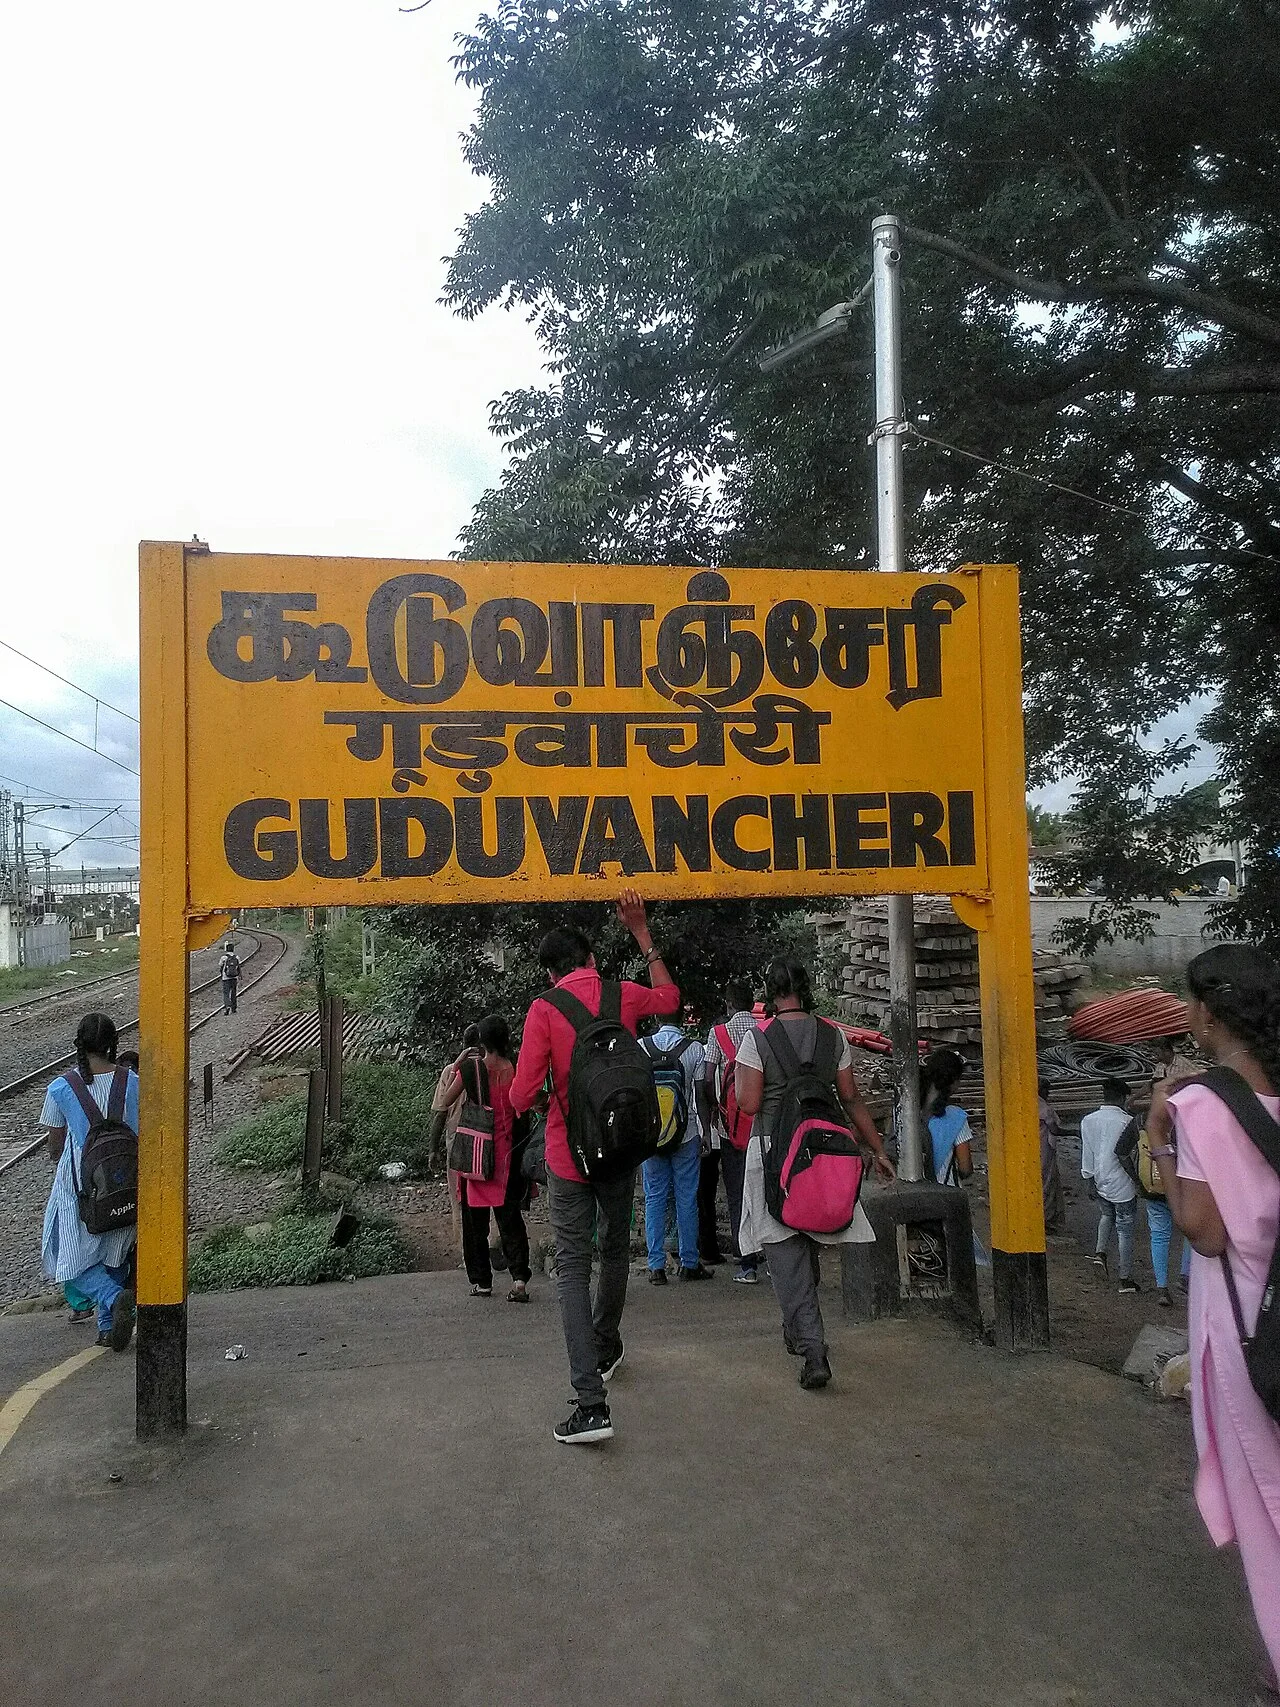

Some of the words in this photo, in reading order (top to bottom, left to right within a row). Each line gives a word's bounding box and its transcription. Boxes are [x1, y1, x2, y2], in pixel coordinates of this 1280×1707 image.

[206, 572, 967, 711] கூடுவாஞ்சேரி
[224, 791, 974, 881] GUDUVANCHERI
[109, 1202, 136, 1217] Apple
